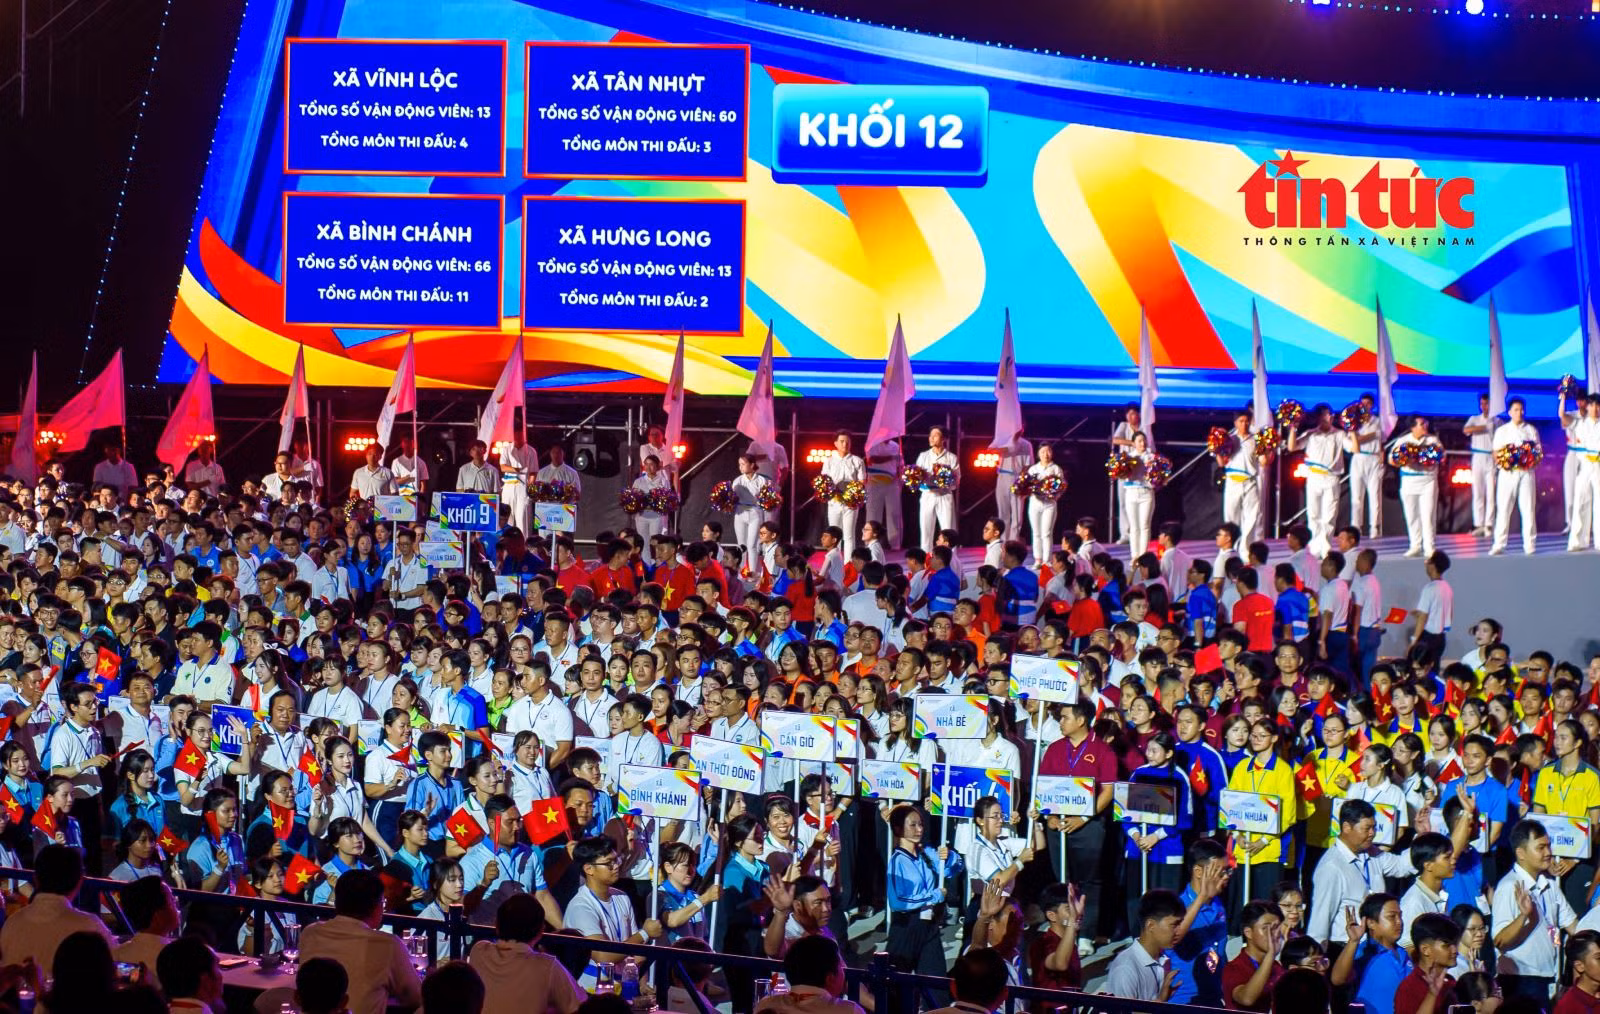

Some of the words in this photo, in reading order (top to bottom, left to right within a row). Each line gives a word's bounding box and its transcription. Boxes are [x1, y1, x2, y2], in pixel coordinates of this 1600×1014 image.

[333, 67, 361, 87] XÃ
[364, 68, 414, 88] VĨNH
[419, 68, 458, 93] LỘC
[571, 71, 600, 91] XÃ
[603, 72, 643, 92] TÂN
[648, 73, 706, 97] NHỰT
[298, 101, 338, 117] TỔNG
[341, 101, 360, 117] SỐ
[362, 102, 392, 119] VẬN
[394, 102, 436, 120] ĐỘNG
[438, 103, 474, 118] VIÊN:
[476, 106, 491, 119] 13
[538, 104, 578, 120] TỔNG
[581, 104, 601, 121] SỐ
[602, 105, 633, 124] VẬN
[635, 106, 677, 124] ĐỘNG
[679, 106, 716, 122] VIÊN:
[718, 110, 737, 123] 60
[800, 98, 905, 147] KHỐI
[919, 114, 963, 148] 12
[320, 132, 360, 147] TỔNG
[362, 133, 396, 148] MÔN
[397, 135, 421, 148] THI
[423, 133, 457, 149] ĐẤU:
[459, 137, 469, 149] 4
[561, 136, 602, 151] TỔNG
[604, 137, 638, 152] MÔN
[640, 140, 664, 152] THI
[666, 137, 701, 153] ĐẤU:
[703, 141, 712, 153] 3
[316, 220, 344, 241] XÃ
[349, 220, 397, 242] BÌNH
[401, 221, 472, 243] CHÁNH
[558, 225, 587, 245] XÃ
[591, 226, 651, 246] HƯNG
[655, 229, 712, 248] LONG
[296, 252, 336, 270] TỔNG
[338, 254, 358, 270] SỐ
[360, 255, 390, 273] VẬN
[391, 256, 433, 274] ĐỘNG
[435, 257, 472, 272] VIÊN:
[474, 260, 492, 273] 66
[537, 257, 577, 274] TỔNG
[579, 258, 599, 275] SỐ
[601, 259, 632, 278] VẬN
[633, 260, 676, 279] ĐỘNG
[678, 261, 715, 277] VIÊN:
[717, 265, 732, 277] 13
[317, 284, 357, 300] TỔNG
[359, 286, 393, 301] MÔN
[394, 289, 418, 302] THI
[420, 286, 454, 302] ĐẤU:
[456, 291, 469, 303] 11
[559, 288, 599, 305] TỔNG
[601, 290, 635, 306] MÔN
[637, 294, 661, 307] THI
[663, 291, 698, 308] ĐẤU:
[700, 295, 709, 308] 2
[447, 504, 477, 524] KHỐI
[480, 503, 490, 525] 9
[695, 759, 707, 771] AN
[732, 765, 756, 782] ĐÔNG
[630, 788, 652, 803] BÌNH
[655, 789, 687, 807] KHÁNH
